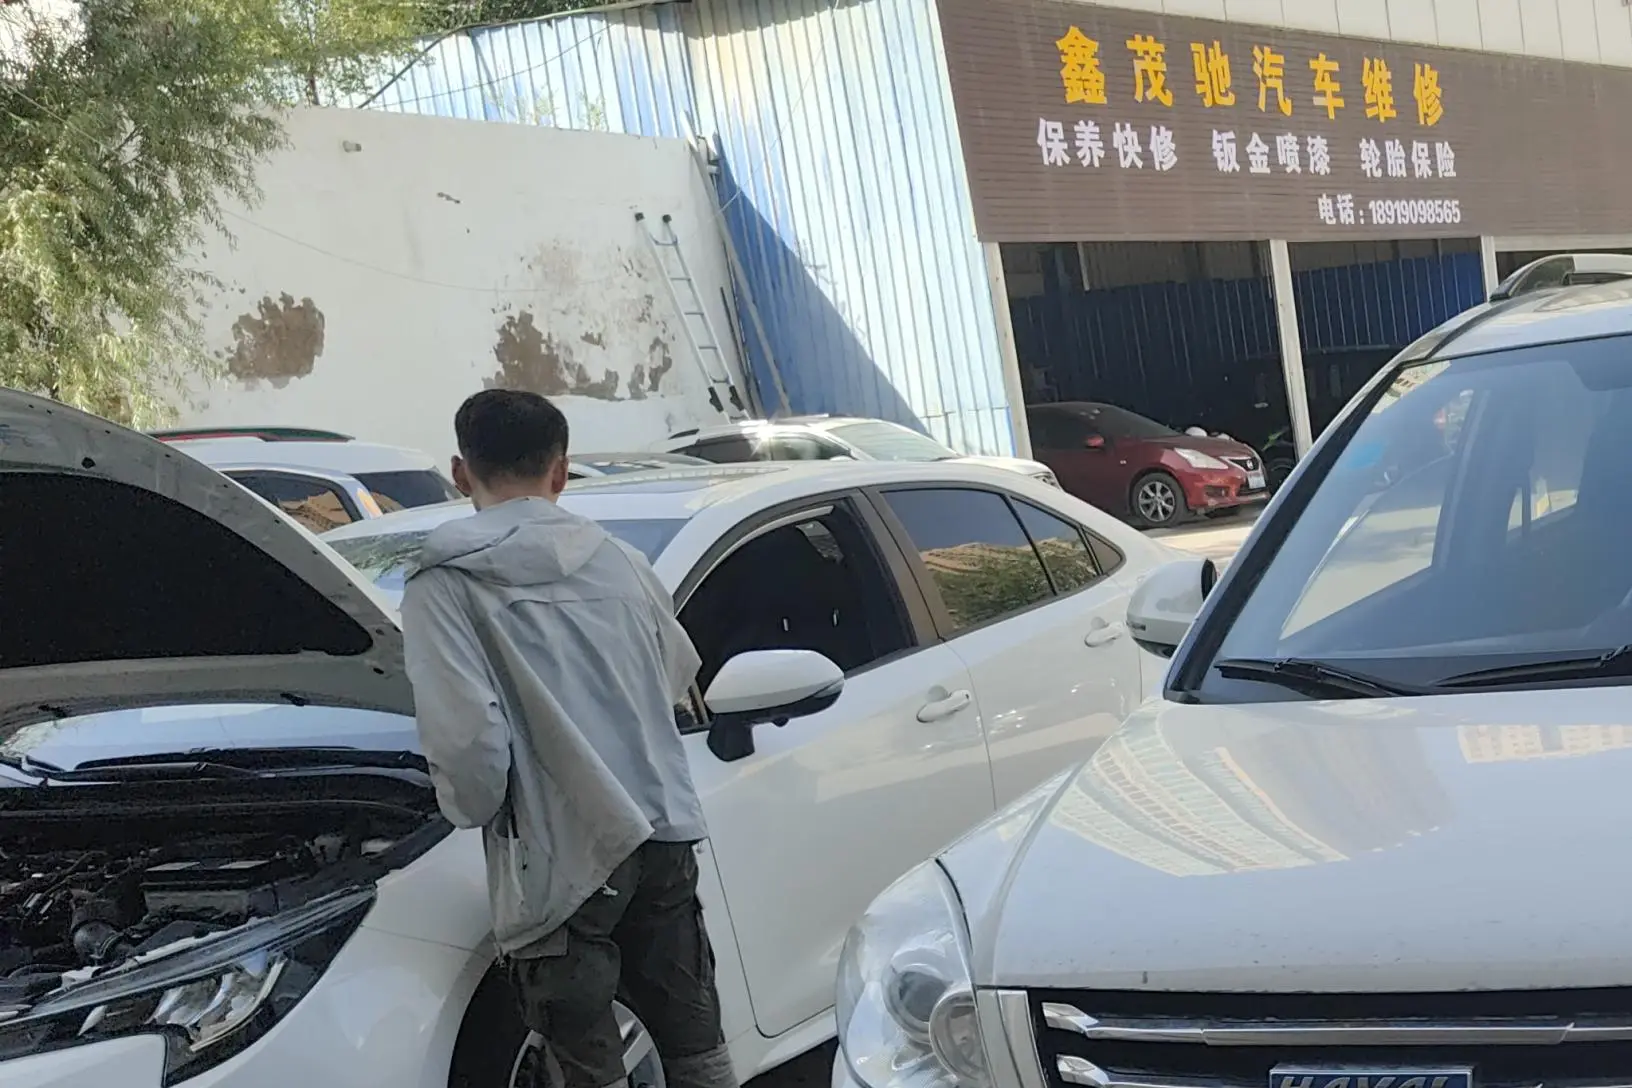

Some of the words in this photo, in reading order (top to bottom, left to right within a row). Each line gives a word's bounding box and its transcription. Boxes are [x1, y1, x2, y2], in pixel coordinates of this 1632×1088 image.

[1056, 25, 1445, 127] 鑫茂驰汽车维修
[1037, 117, 1178, 171] 保养快修
[1212, 128, 1331, 175] 钣金喷漆
[1358, 137, 1457, 179] 轮胎保险
